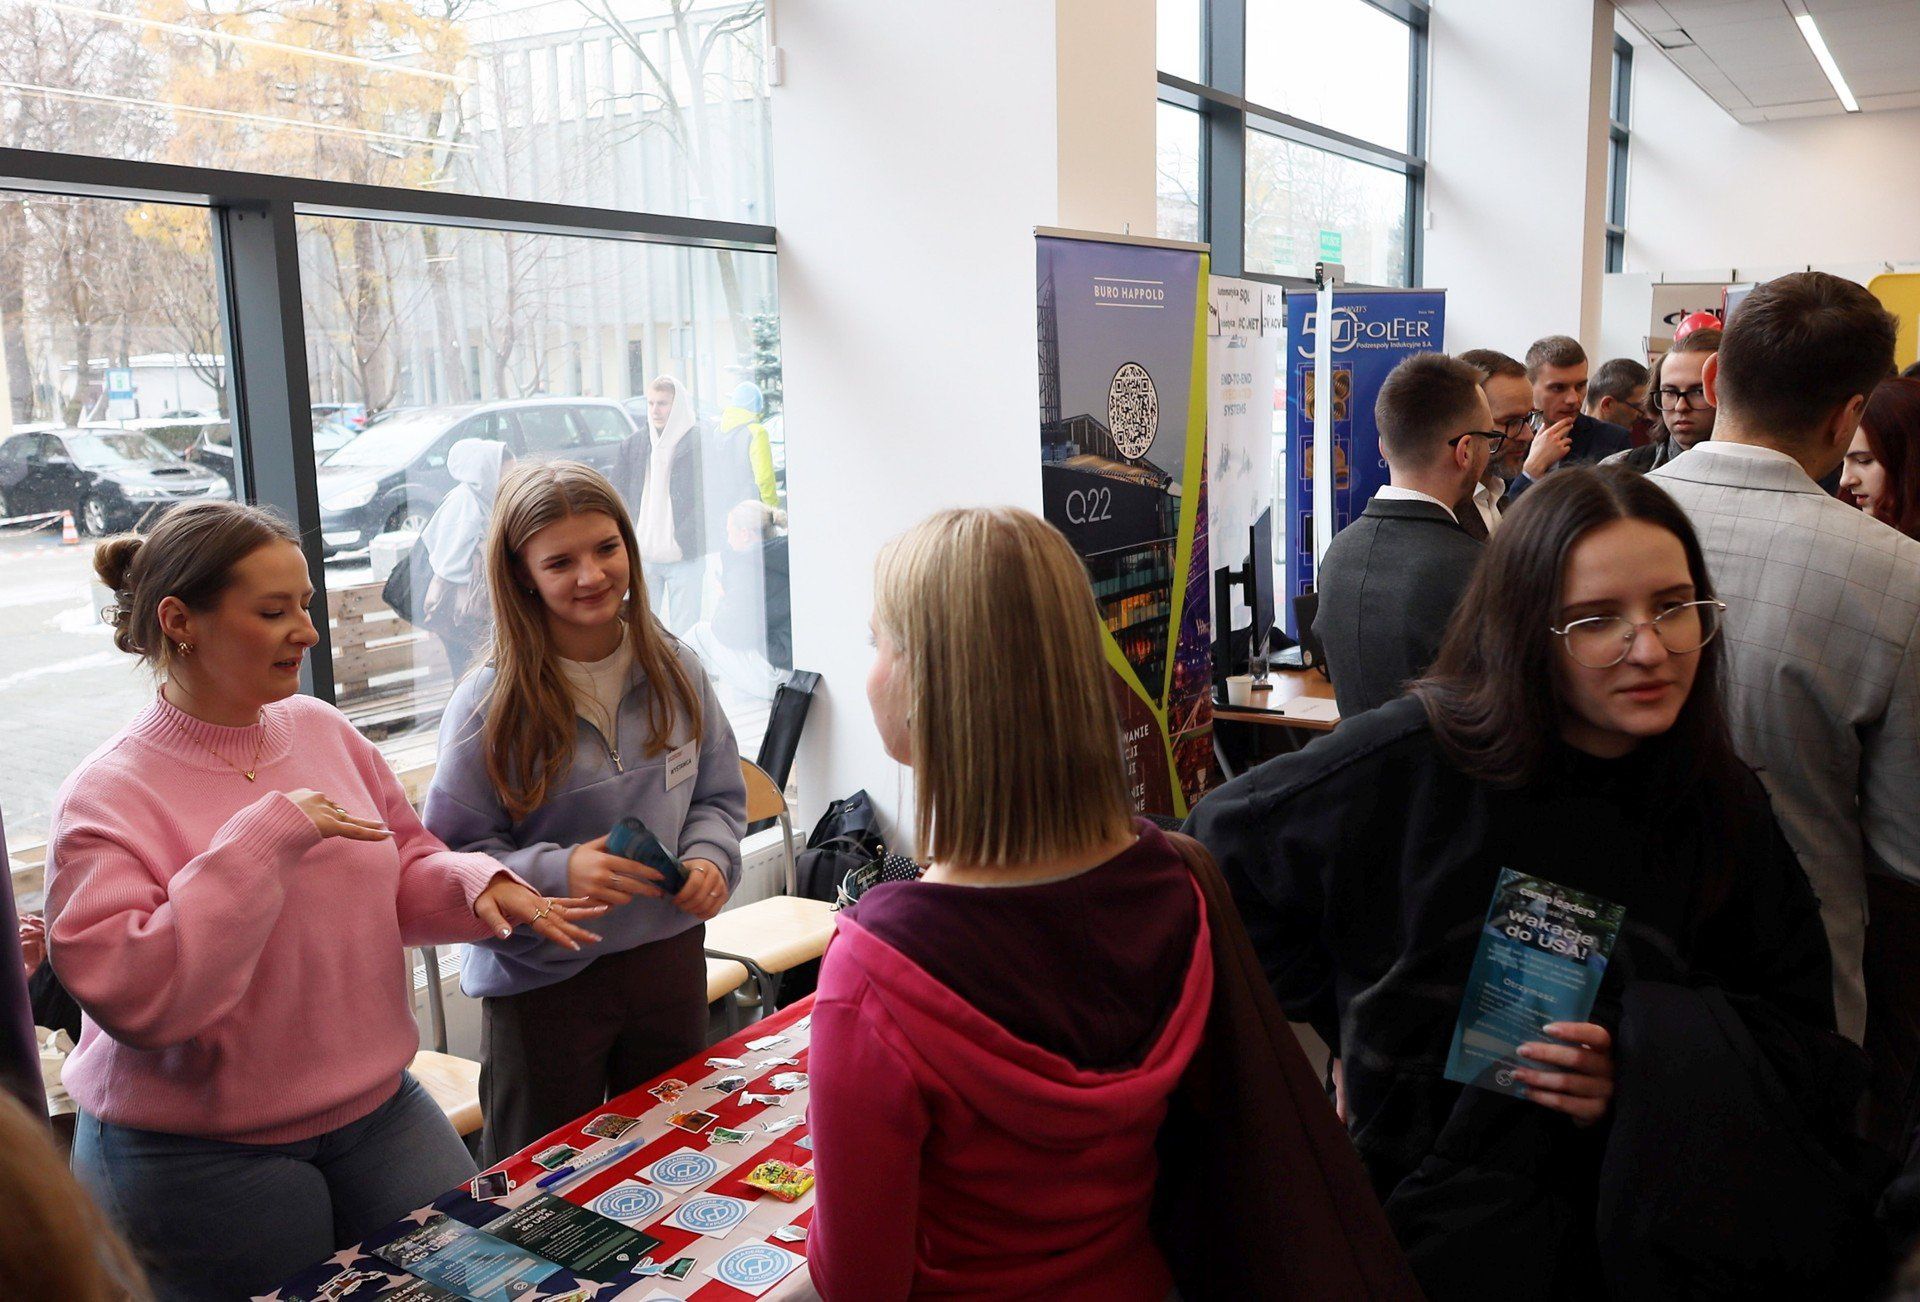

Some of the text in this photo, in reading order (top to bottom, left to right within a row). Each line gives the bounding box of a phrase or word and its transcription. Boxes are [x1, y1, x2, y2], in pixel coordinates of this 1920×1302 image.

[1094, 285, 1164, 300] BURO HAPPOLD
[1354, 318, 1430, 341] POLFER
[1066, 487, 1112, 524] Q22
[1509, 909, 1594, 946] wakacje
[1505, 925, 1588, 960] do USA!
[512, 1208, 547, 1229] wakacje
